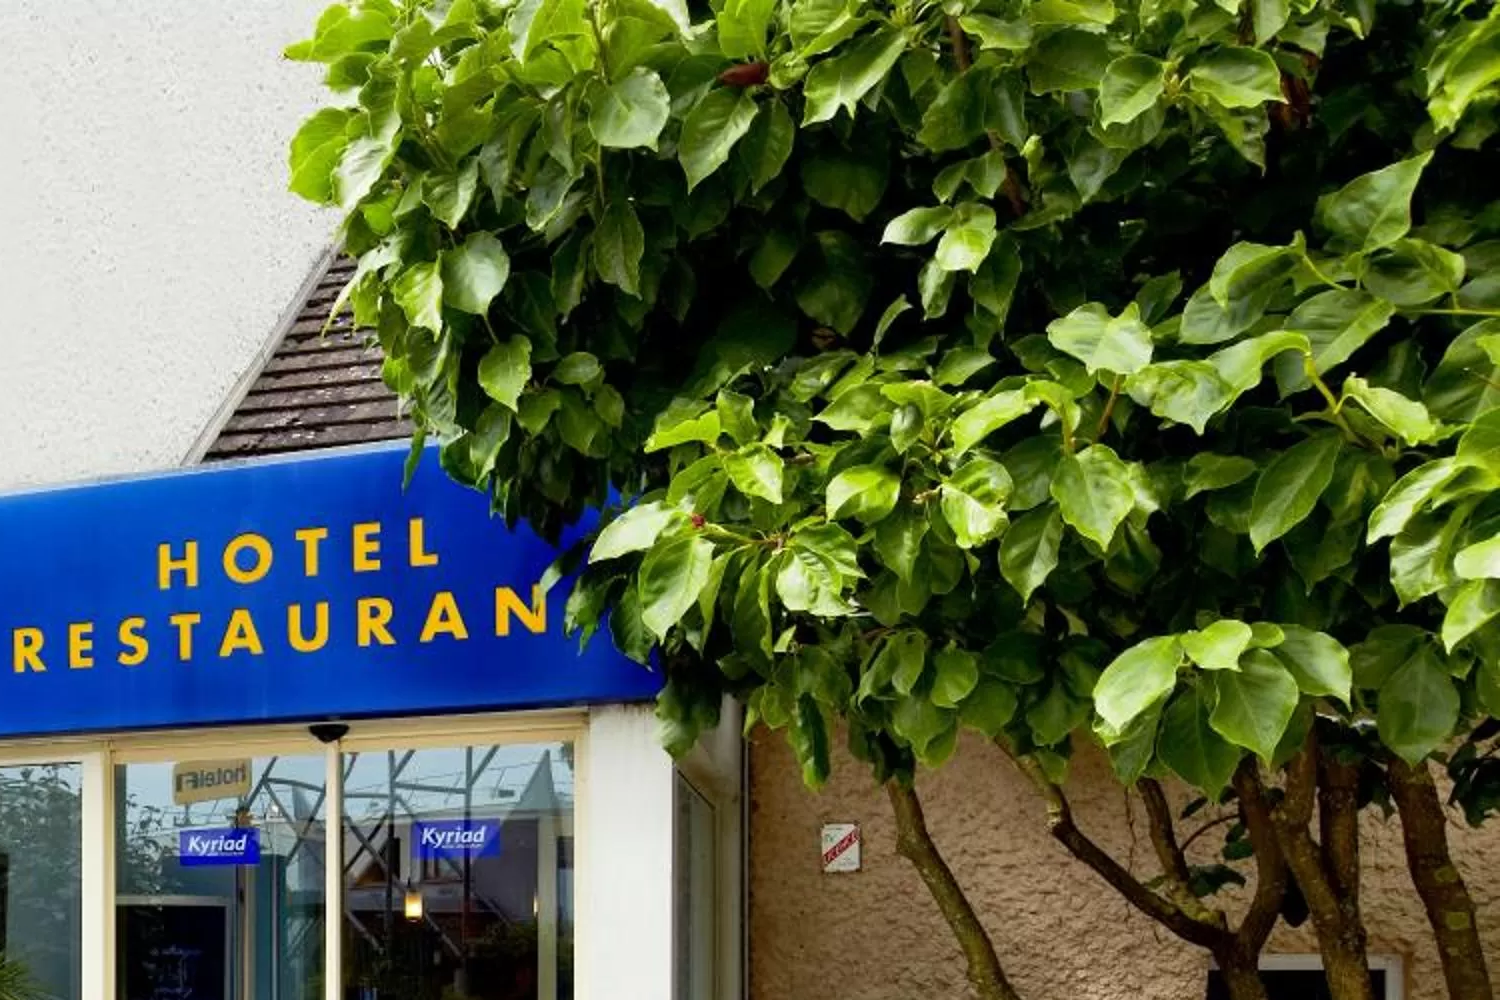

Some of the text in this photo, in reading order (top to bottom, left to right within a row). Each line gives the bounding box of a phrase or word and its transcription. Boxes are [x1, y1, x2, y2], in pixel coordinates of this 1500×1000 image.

[157, 517, 440, 591] HOTEL
[12, 585, 548, 673] RESTAURAN
[187, 834, 247, 856] Kyriad
[421, 825, 487, 849] Kyriad
